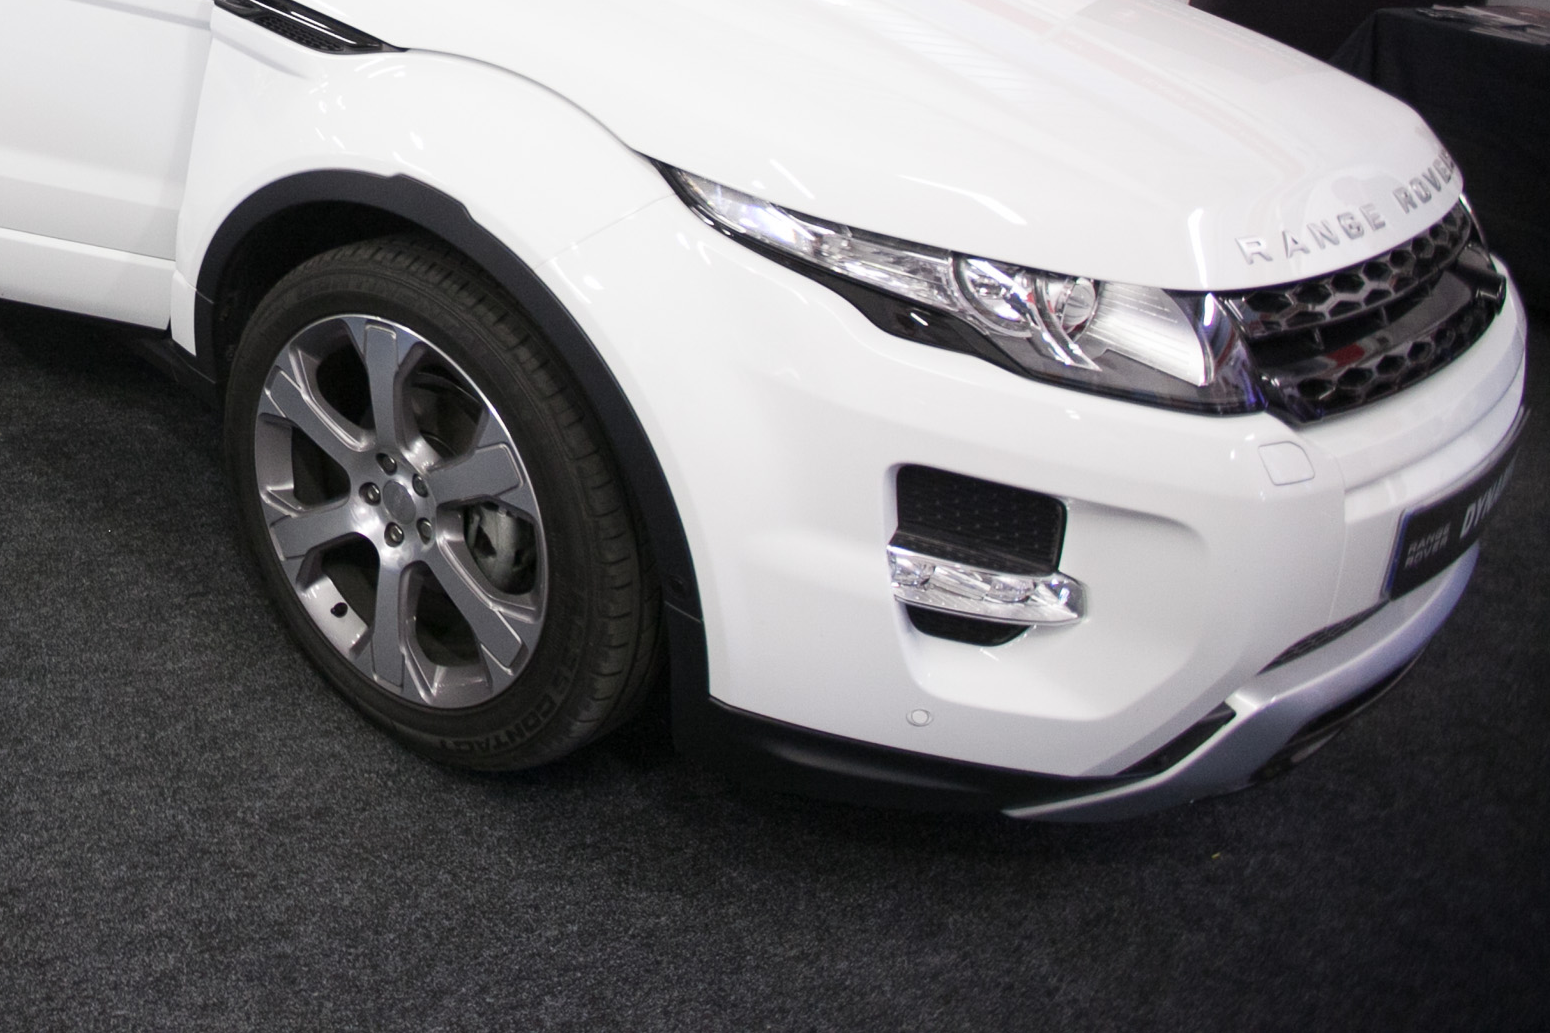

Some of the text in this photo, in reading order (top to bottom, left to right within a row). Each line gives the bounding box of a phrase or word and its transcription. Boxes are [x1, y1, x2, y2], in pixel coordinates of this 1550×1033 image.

[1235, 203, 1386, 265] RANGE
[1404, 532, 1449, 568] ROVER
[1407, 521, 1450, 557] RANGE
